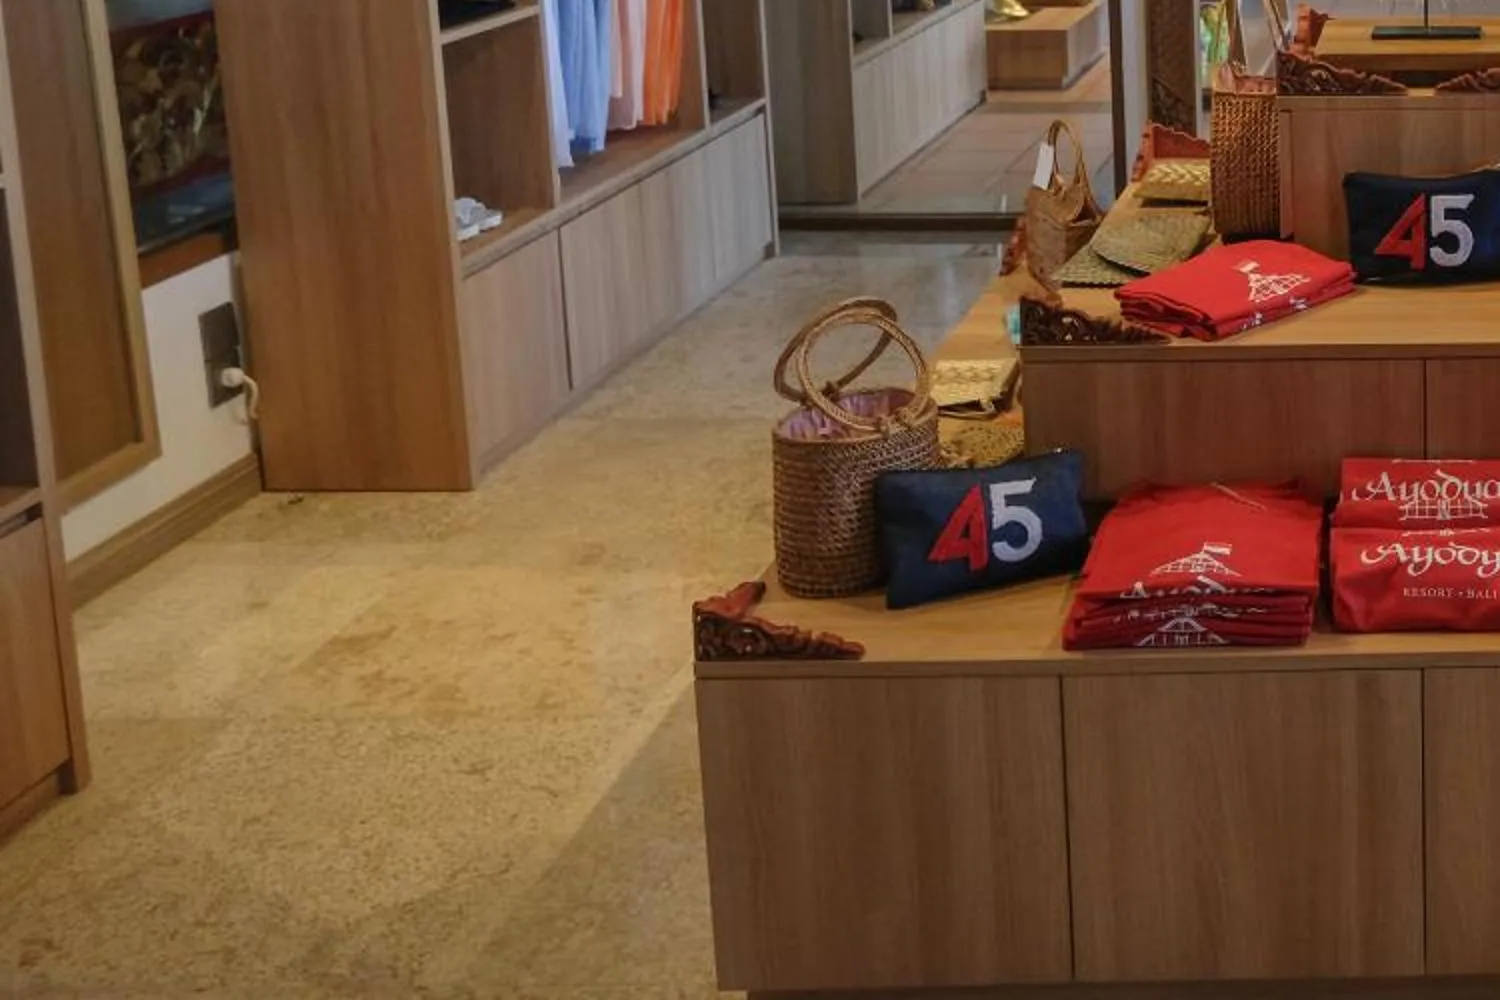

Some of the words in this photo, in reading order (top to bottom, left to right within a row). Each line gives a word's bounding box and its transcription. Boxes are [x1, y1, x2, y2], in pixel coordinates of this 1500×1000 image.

[1375, 194, 1475, 269] 45
[928, 476, 1043, 570] 45
[1402, 587, 1452, 599] RESORT
[1466, 589, 1499, 600] BALI
